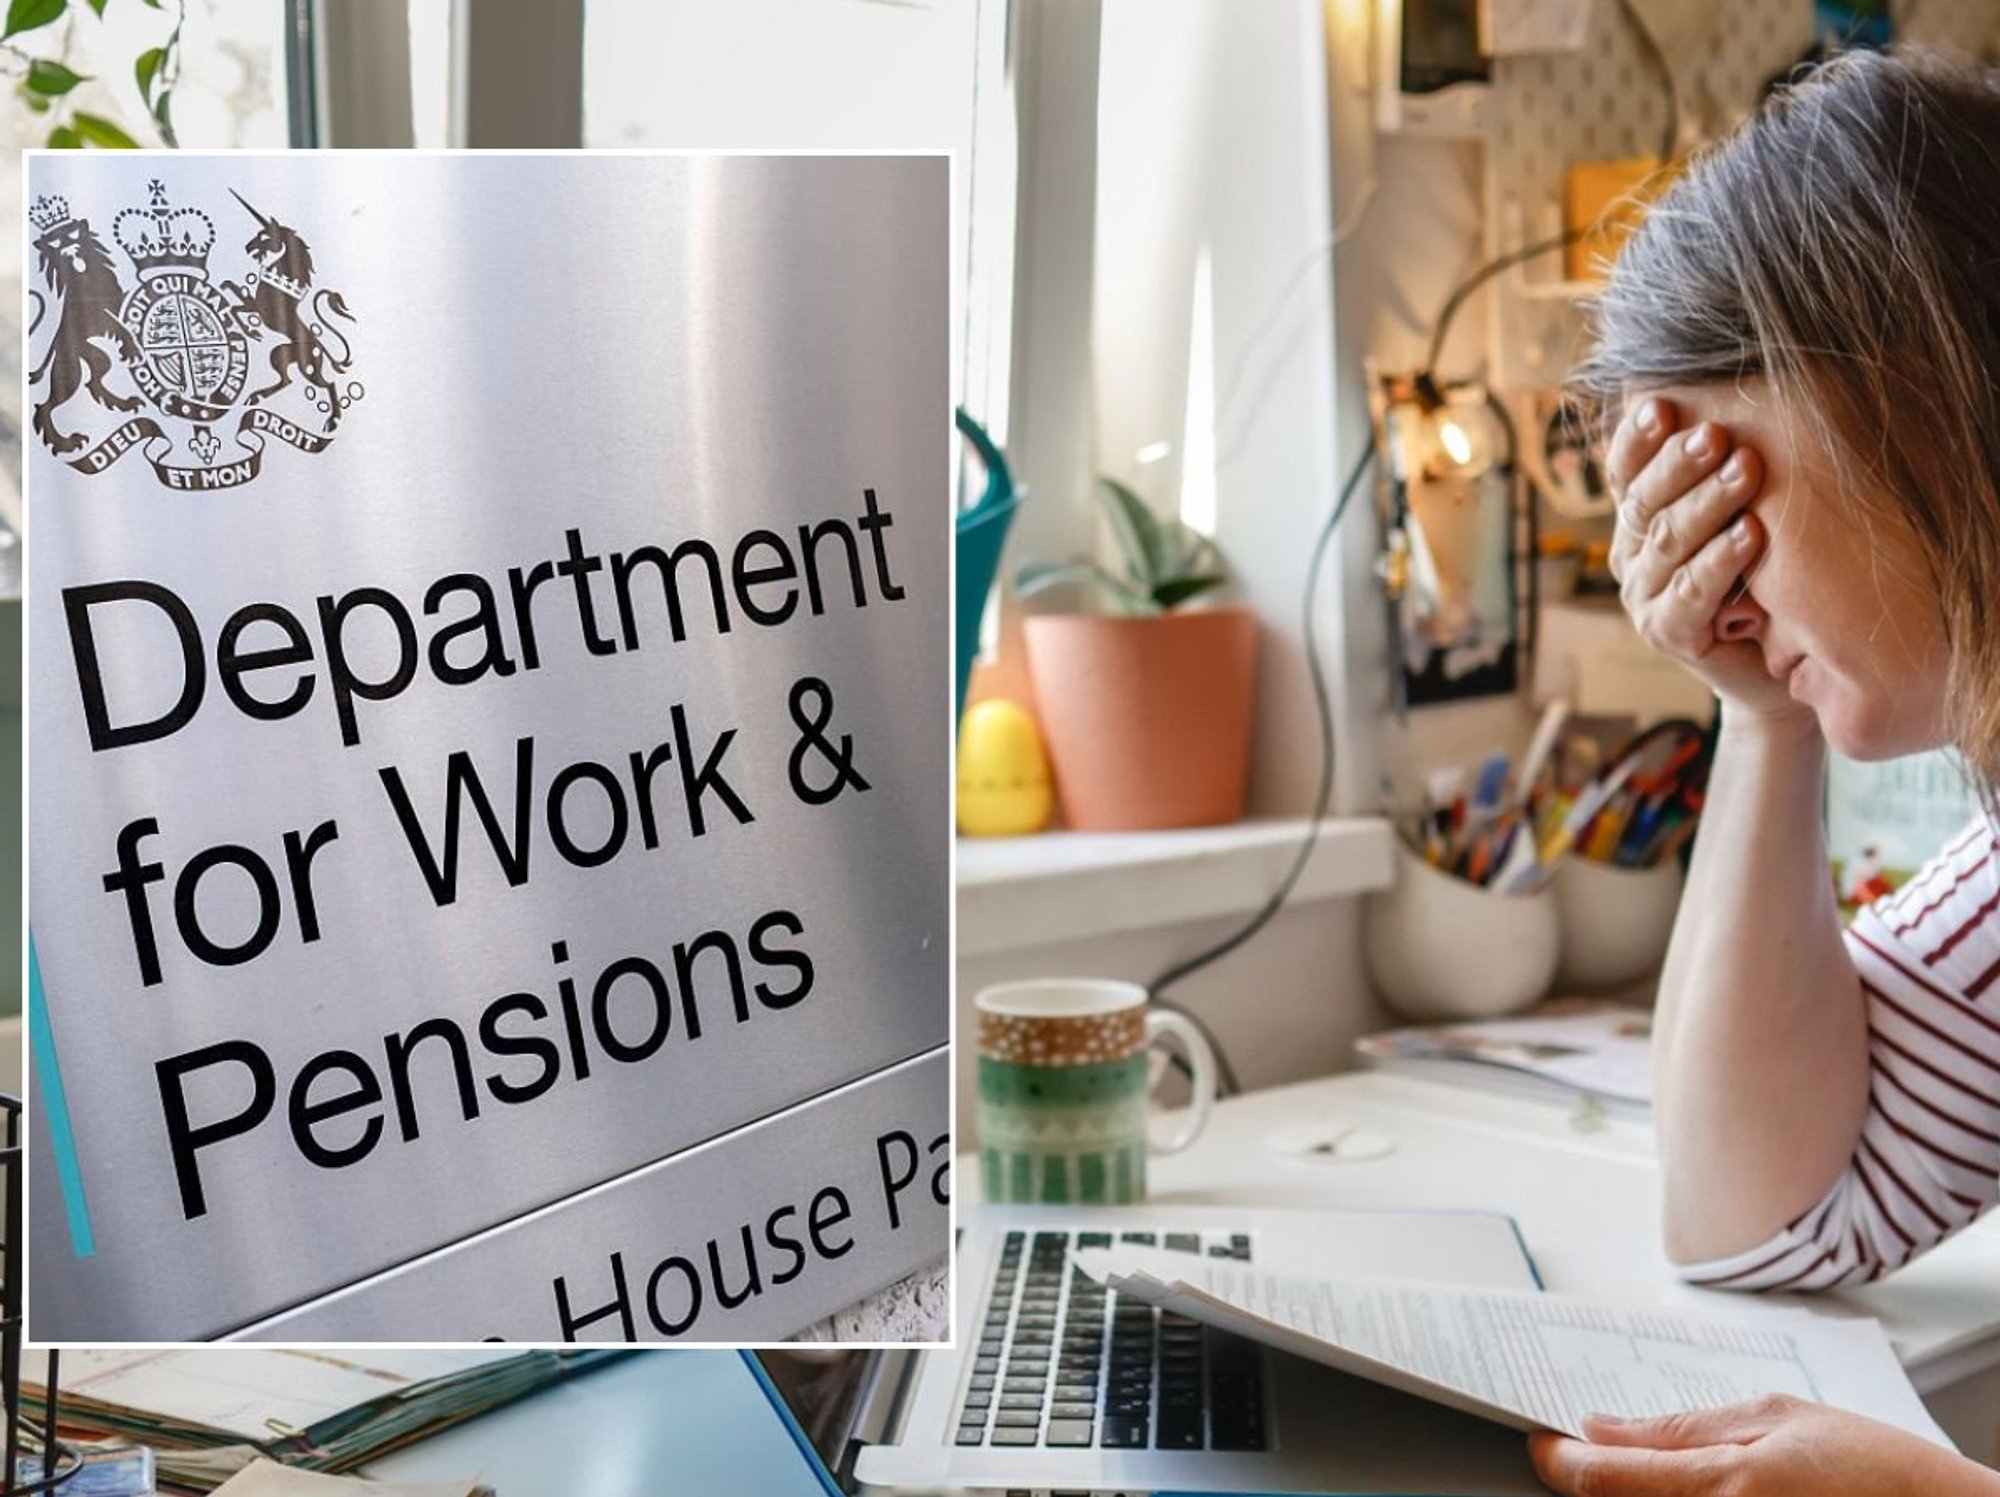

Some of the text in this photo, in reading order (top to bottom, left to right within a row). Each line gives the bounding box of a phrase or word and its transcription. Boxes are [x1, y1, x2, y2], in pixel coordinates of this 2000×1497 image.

[151, 276, 189, 294] QUI
[220, 339, 247, 401] PENSE
[89, 422, 142, 470] DIEU
[169, 461, 252, 489] ET MON
[253, 409, 319, 452] DROIT
[62, 488, 906, 752] Department
[102, 677, 873, 988] for Work &
[154, 910, 815, 1221] Pensions
[553, 1186, 855, 1342] House
